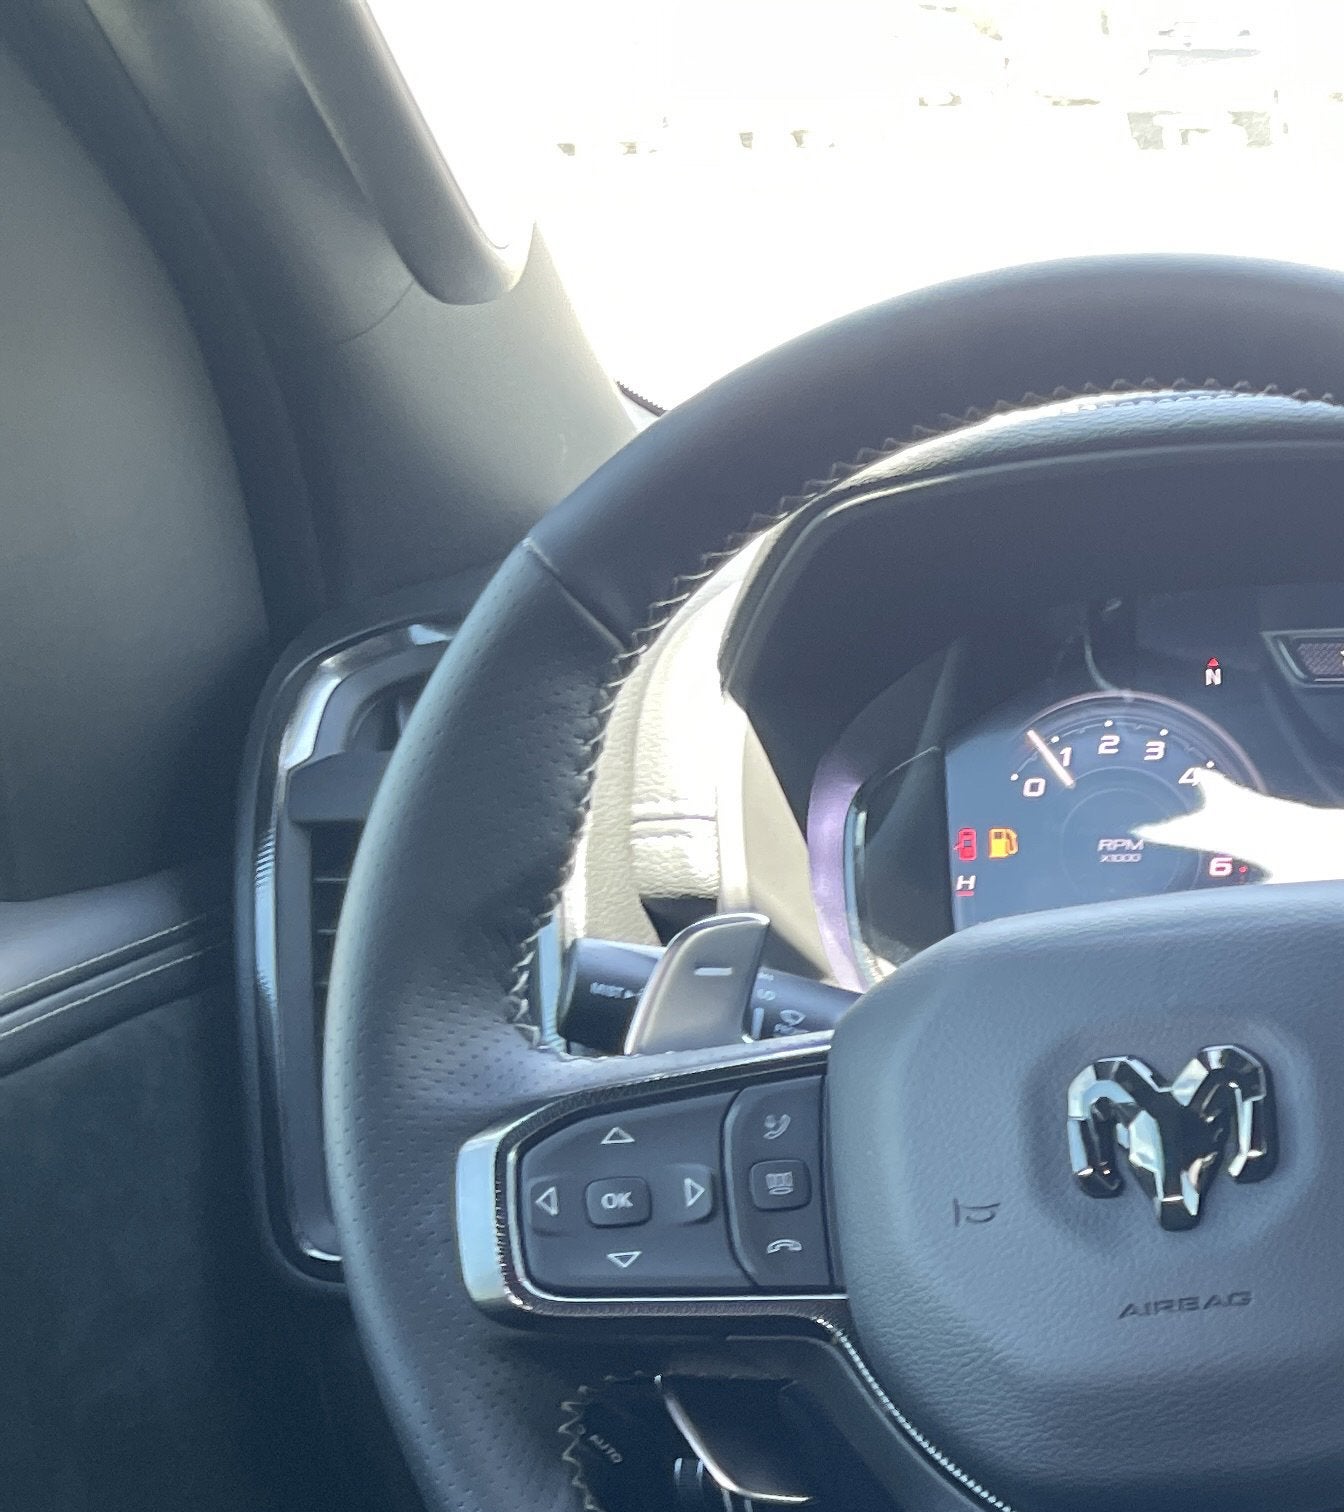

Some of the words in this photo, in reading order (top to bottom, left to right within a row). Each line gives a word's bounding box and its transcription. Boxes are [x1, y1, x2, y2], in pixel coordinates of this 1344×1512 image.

[1205, 668, 1222, 686] N
[1098, 735, 1121, 754] 2
[1143, 740, 1166, 761] 3
[1059, 747, 1072, 767] 1
[1022, 778, 1046, 798] 0
[1097, 838, 1145, 851] RPM
[1208, 856, 1233, 878] 6
[601, 1190, 634, 1209] OK
[1116, 1290, 1253, 1320] AIRBAG
